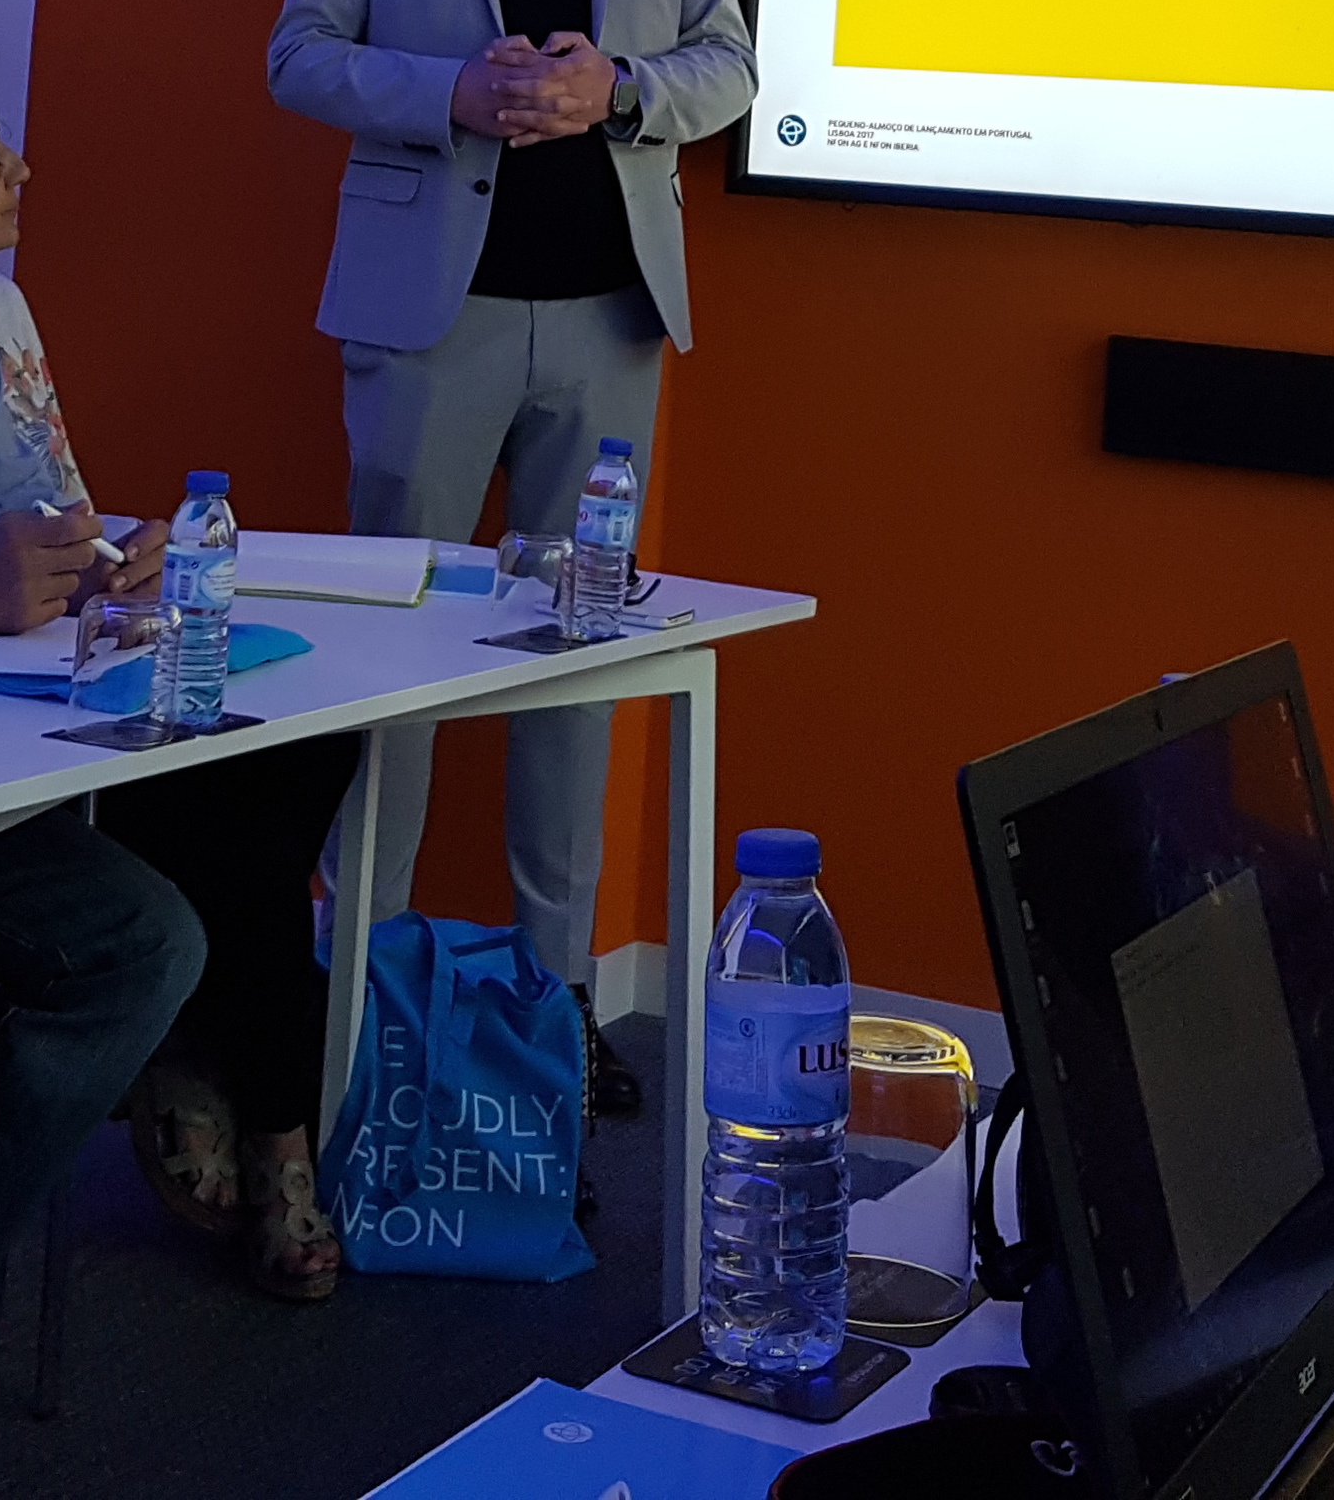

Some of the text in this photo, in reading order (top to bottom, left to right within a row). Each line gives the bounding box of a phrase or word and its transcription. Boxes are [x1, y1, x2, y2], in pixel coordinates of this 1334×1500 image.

[827, 129, 875, 139] LISBOA 2017
[828, 119, 1033, 139] PEQUENO-ALMOÇO DE LANÇAMENTO EM PORTUGAL
[893, 142, 920, 151] IBERIA
[799, 1038, 848, 1074] LUS
[330, 1182, 464, 1248] NFON
